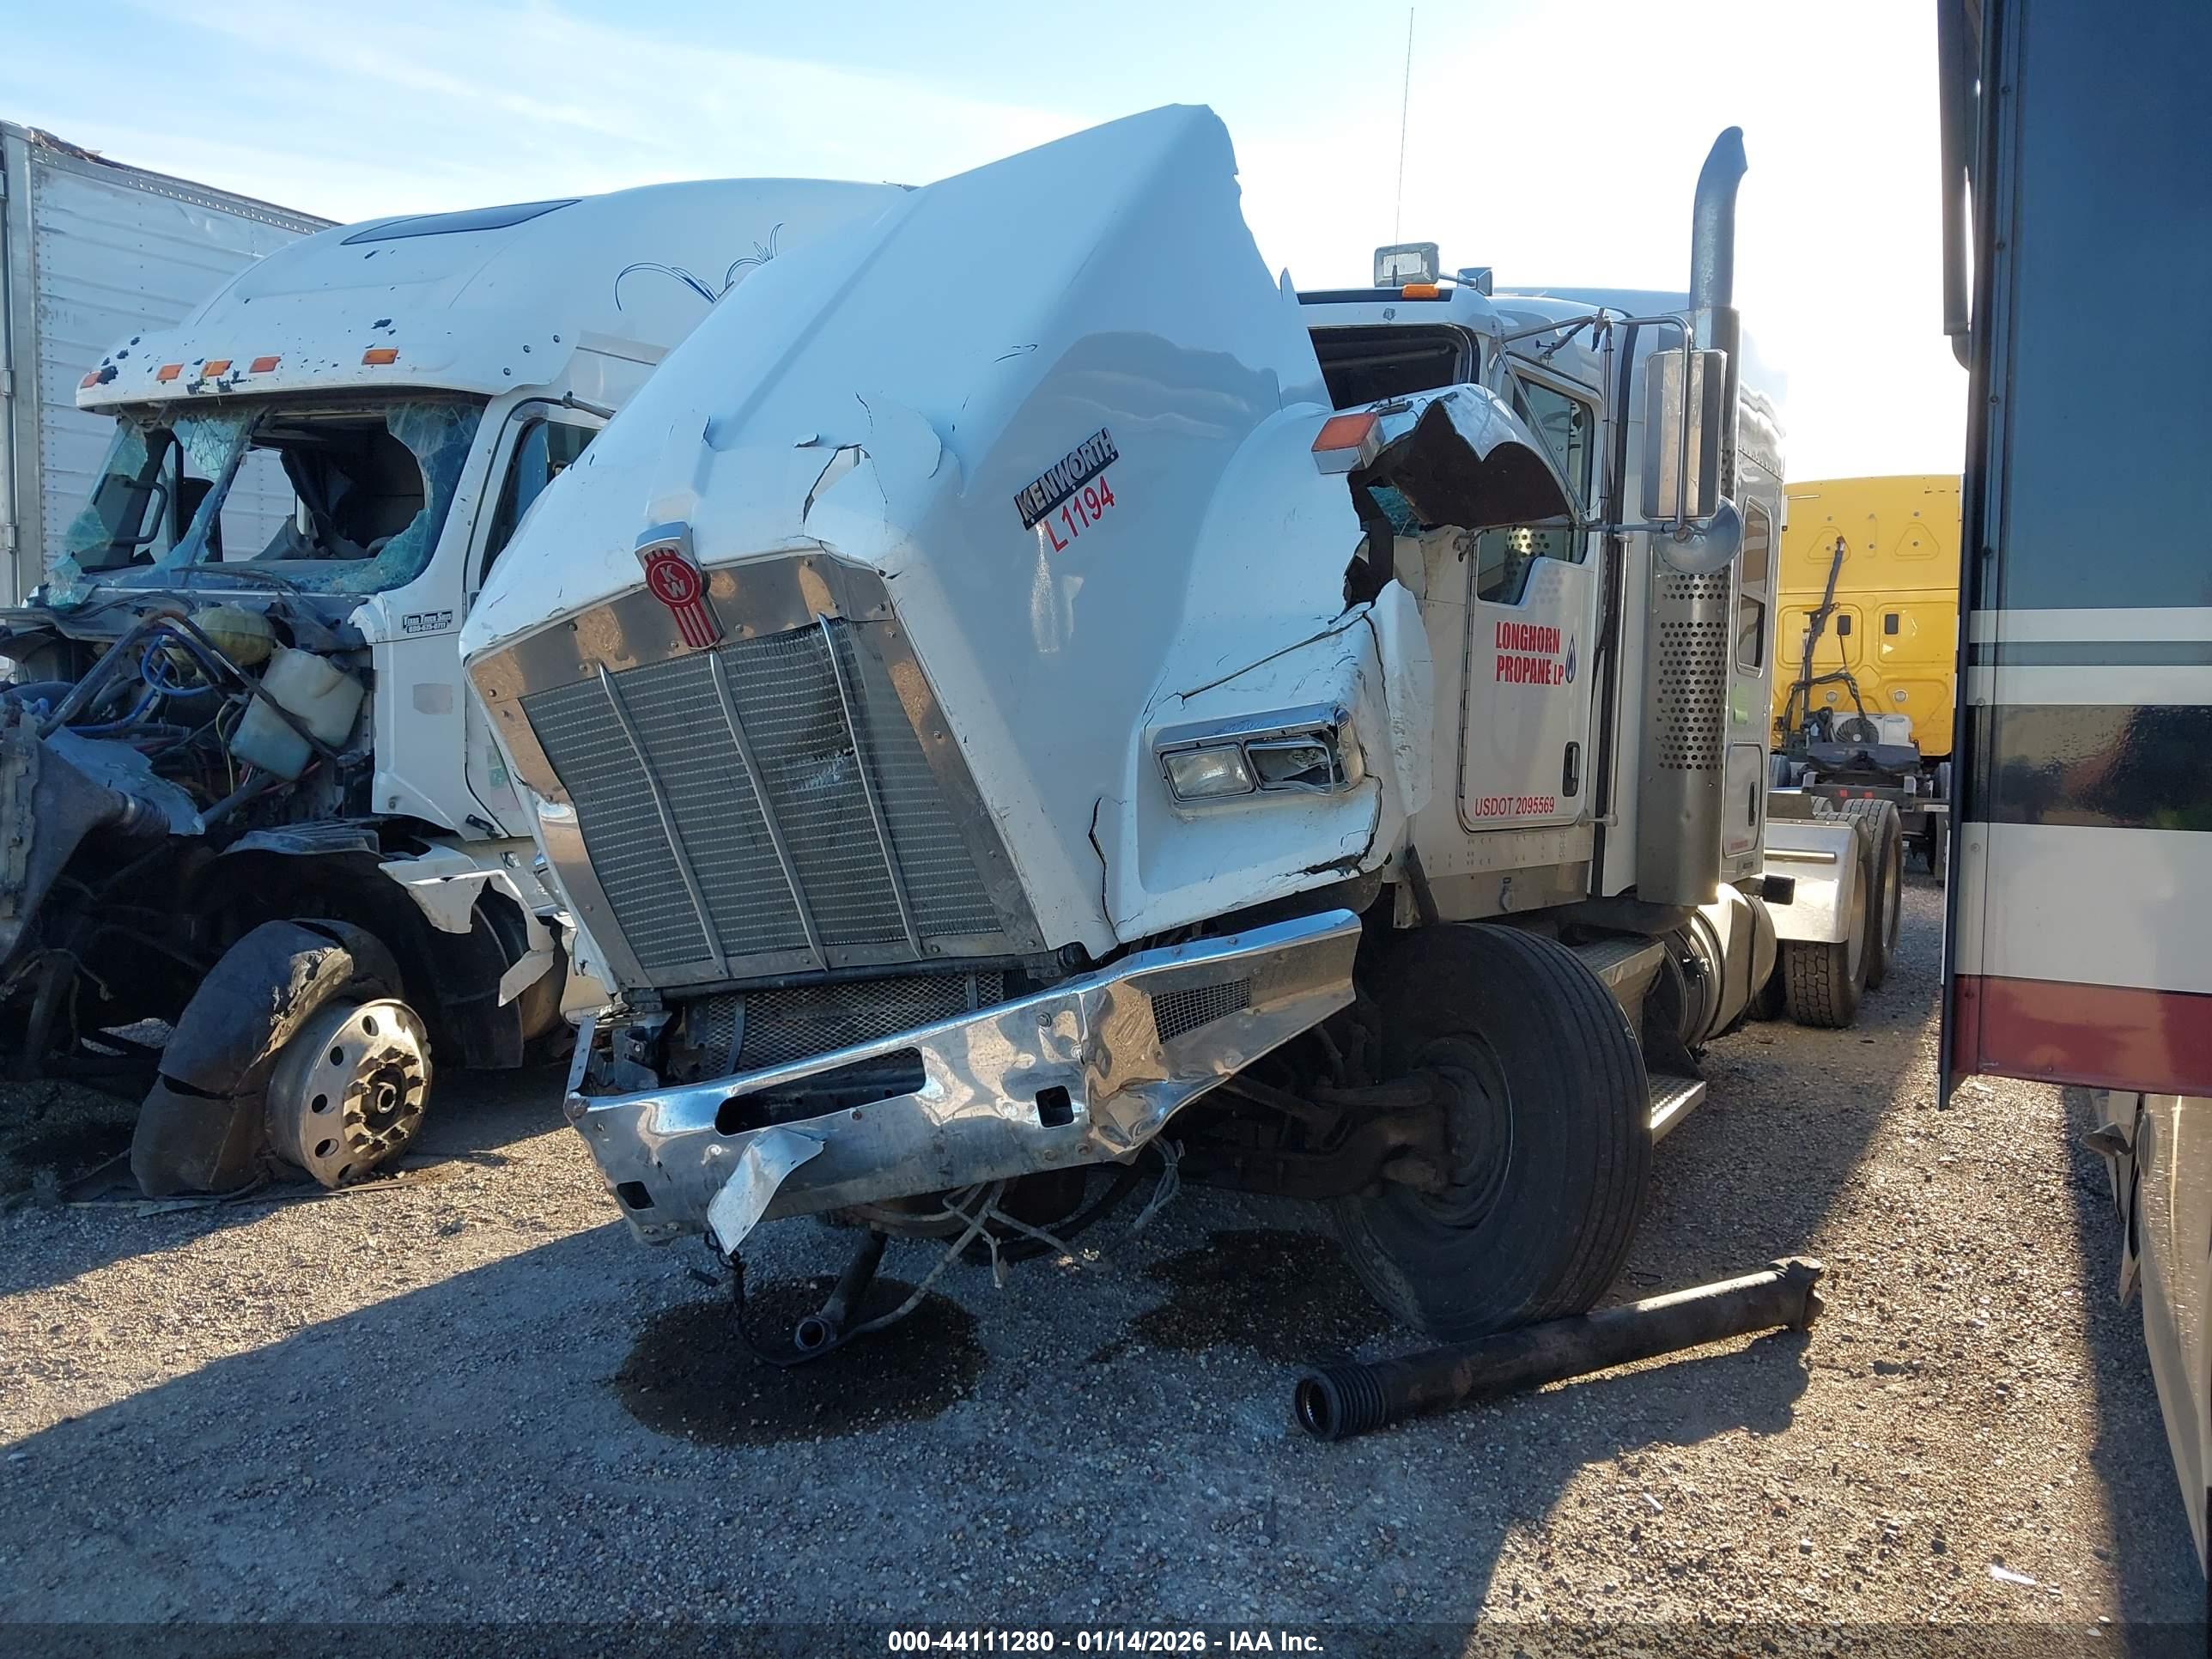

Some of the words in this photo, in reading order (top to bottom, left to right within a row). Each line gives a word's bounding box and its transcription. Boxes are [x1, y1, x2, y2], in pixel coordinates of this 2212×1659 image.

[1015, 428, 1117, 522] KENWORTH
[1043, 475, 1115, 553] L1194
[1496, 621, 1560, 654] LONGHORN
[1496, 655, 1551, 685] PROPANE
[1553, 664, 1564, 685] LP
[1475, 797, 1514, 817] USDOT
[1516, 796, 1554, 815] 2095569
